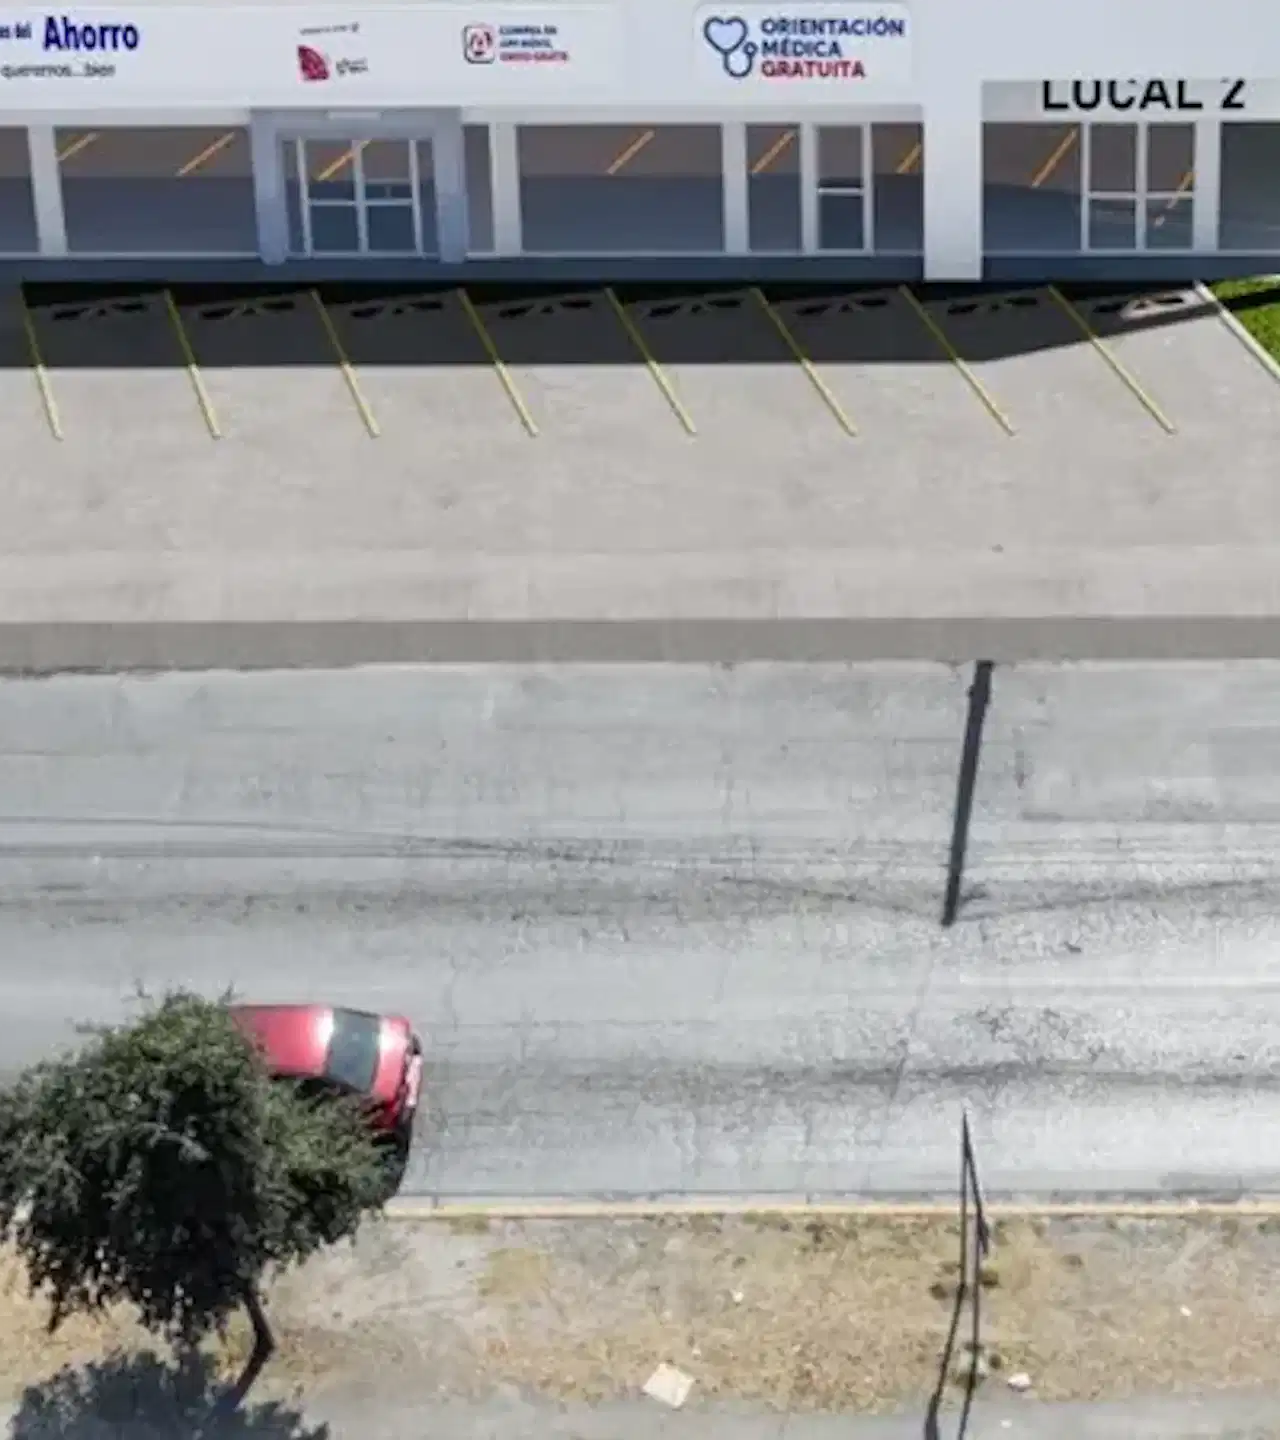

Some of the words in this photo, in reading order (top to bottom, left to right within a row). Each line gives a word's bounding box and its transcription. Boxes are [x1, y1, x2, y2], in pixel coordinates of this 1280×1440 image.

[42, 15, 140, 51] Ahorro
[760, 16, 905, 37] ORIENTACIÓN
[761, 37, 842, 58] MÉDICA
[761, 59, 866, 78] GRATUITA
